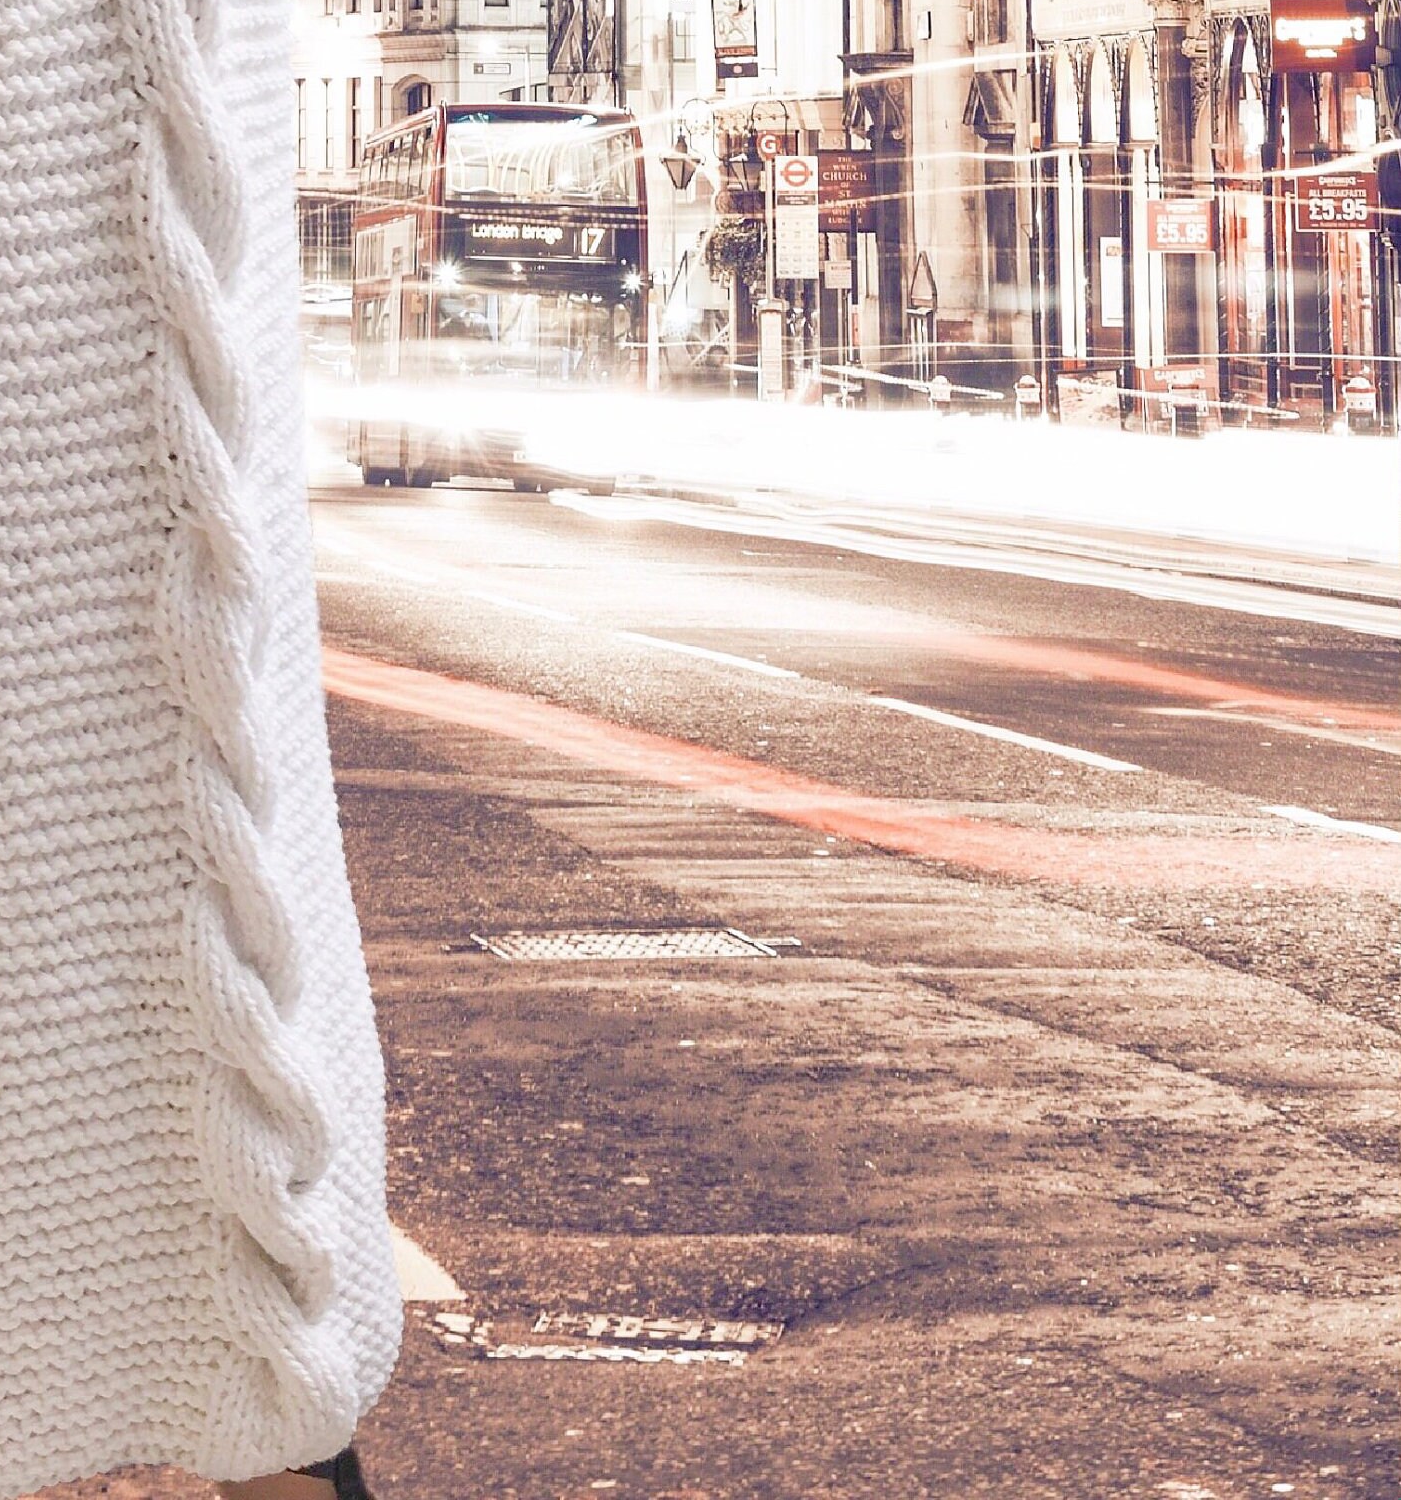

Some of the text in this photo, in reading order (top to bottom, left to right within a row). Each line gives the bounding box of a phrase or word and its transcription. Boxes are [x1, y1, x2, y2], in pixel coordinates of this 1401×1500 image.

[761, 135, 777, 154] G
[822, 172, 867, 181] CHURCH
[1309, 189, 1320, 197] ALL
[1309, 198, 1367, 220] £5.95
[472, 223, 519, 238] London
[581, 227, 606, 255] 17
[1157, 223, 1208, 243] £5.95
